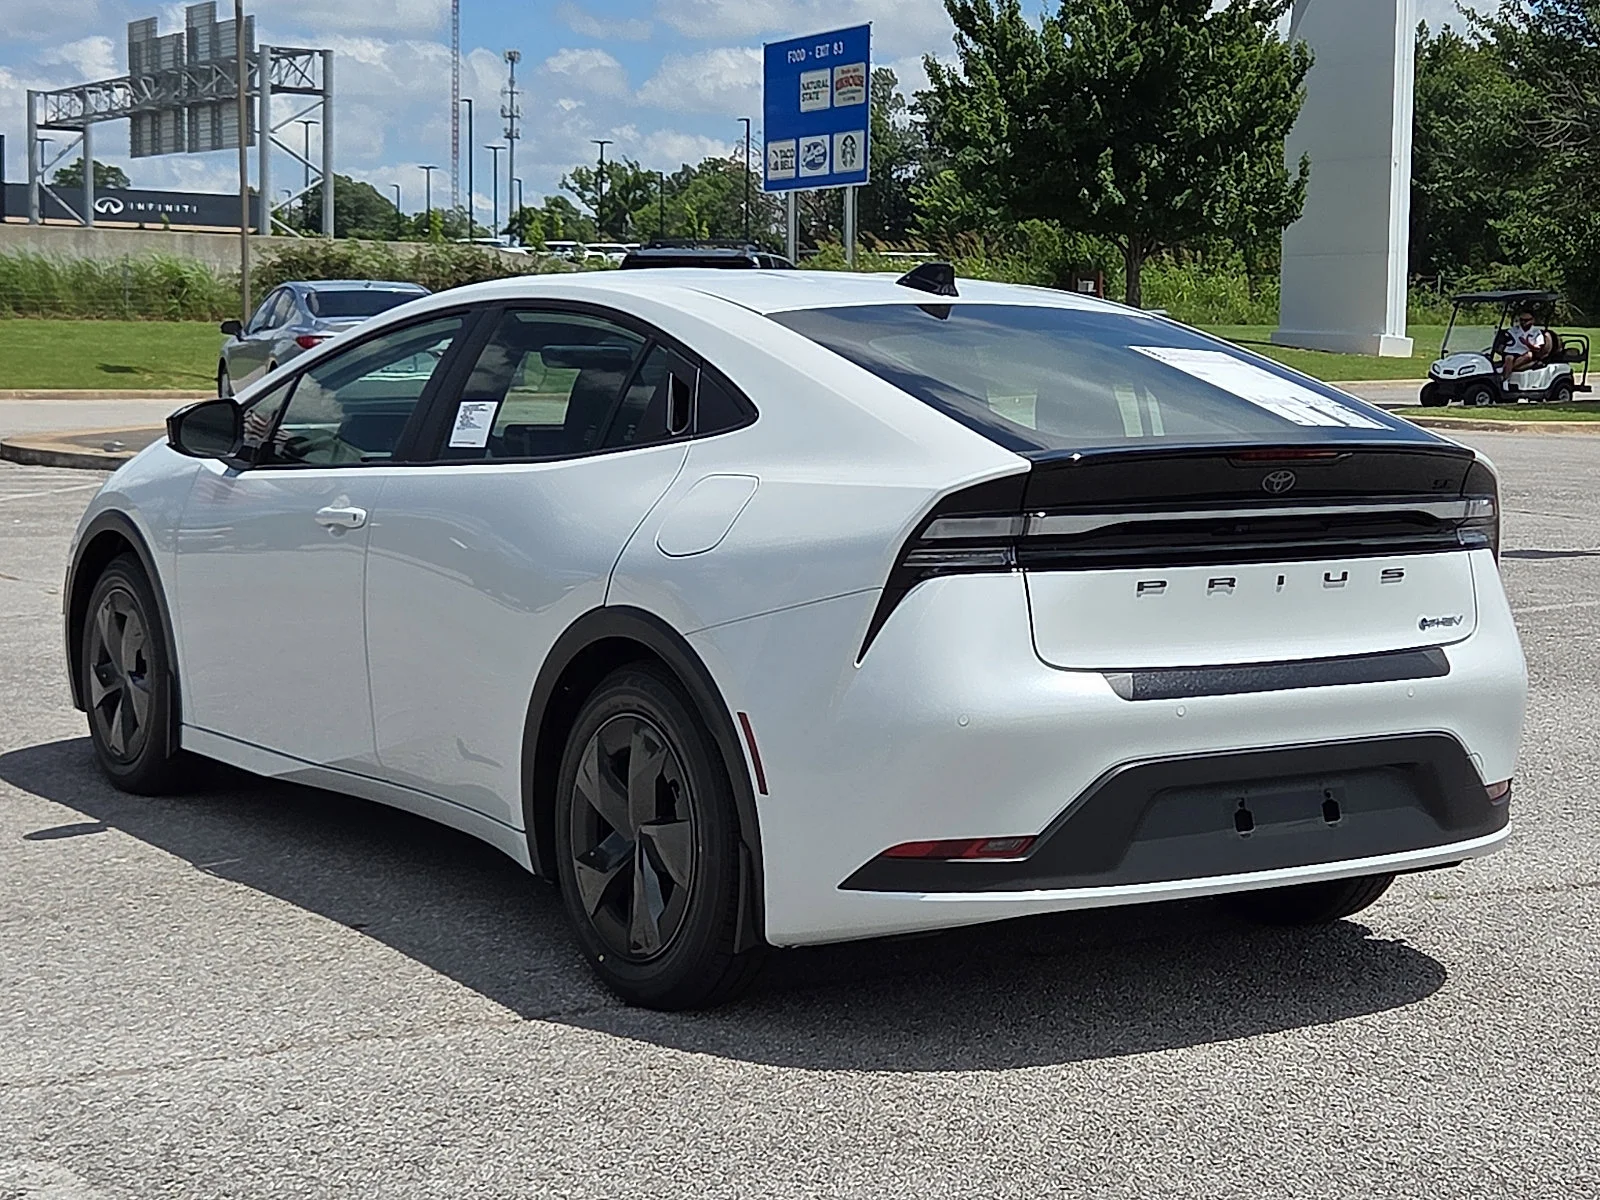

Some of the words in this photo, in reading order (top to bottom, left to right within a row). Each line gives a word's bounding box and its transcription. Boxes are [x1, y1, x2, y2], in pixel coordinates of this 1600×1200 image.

[787, 48, 806, 64] FOOD
[815, 43, 830, 59] EXIT
[801, 79, 829, 91] NATURAL
[801, 90, 820, 102] STATE
[779, 148, 795, 159] TACO
[780, 159, 795, 170] BELL
[129, 202, 197, 214] INFINITI
[1137, 567, 1405, 592] PRIUS
